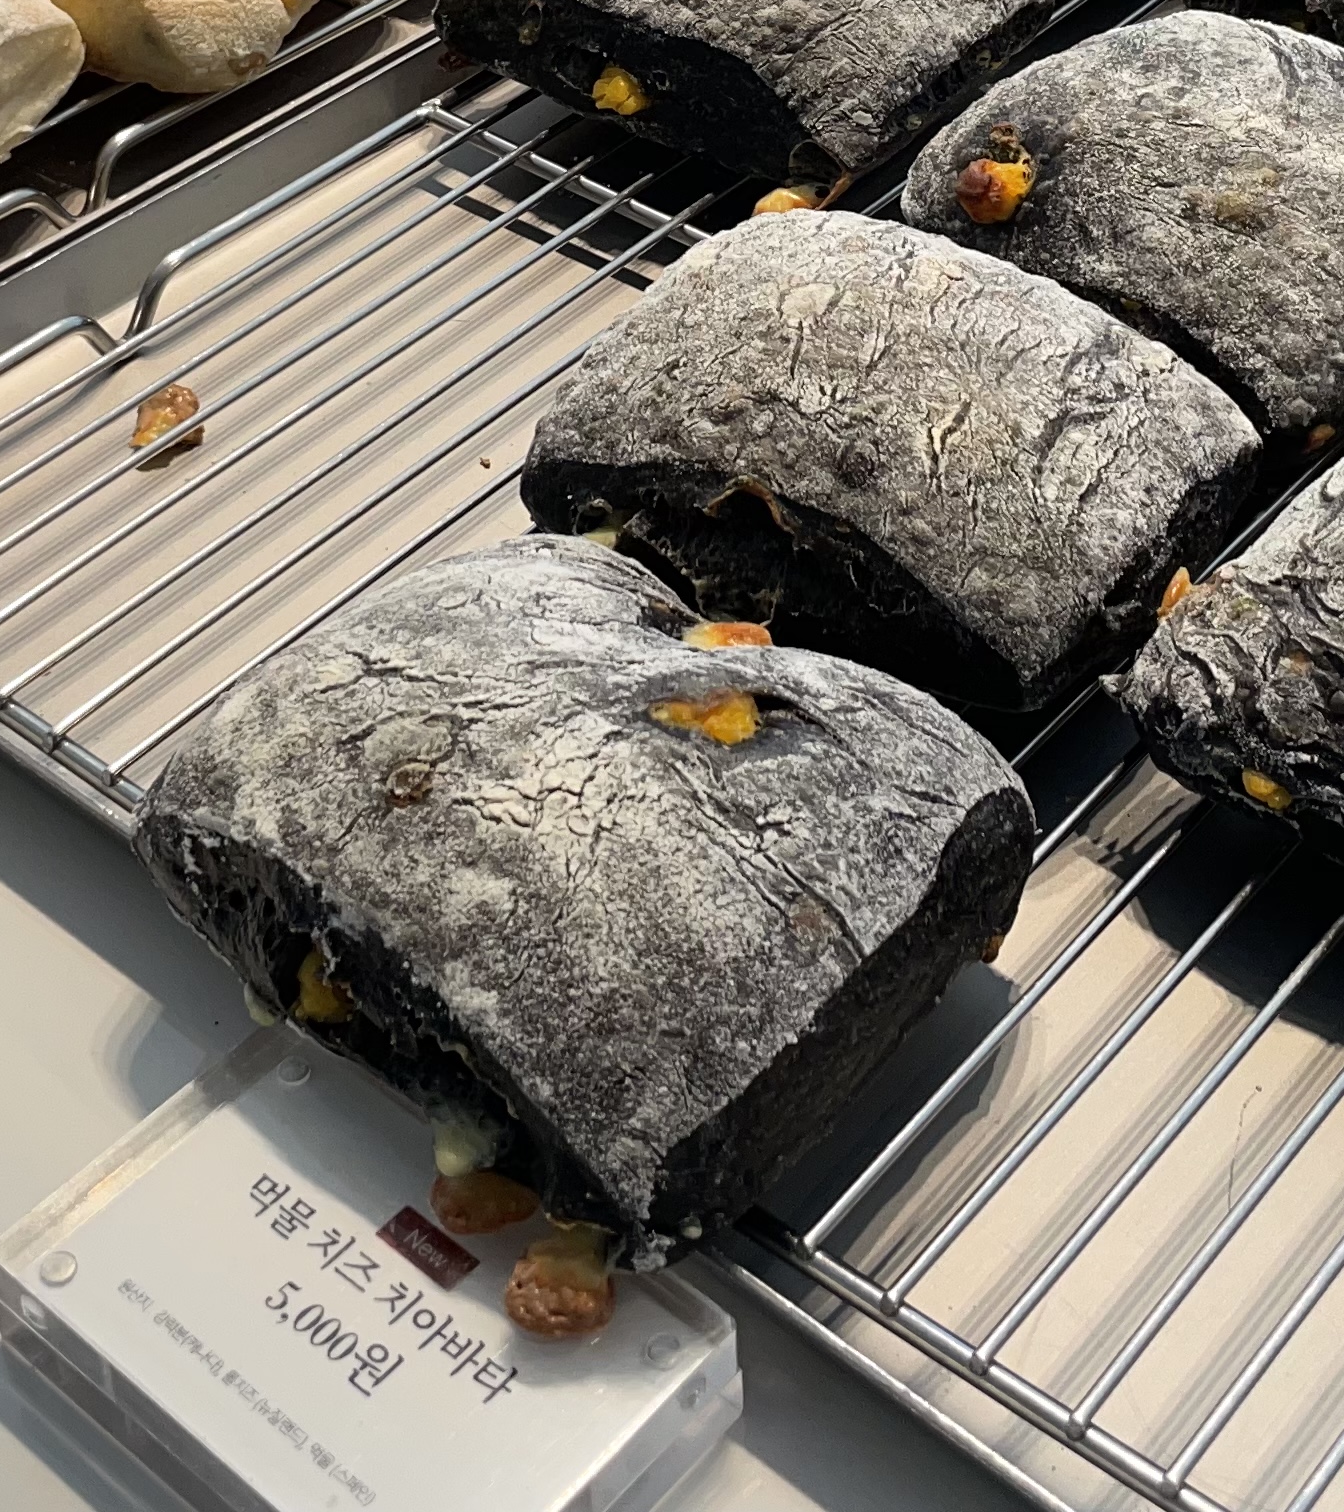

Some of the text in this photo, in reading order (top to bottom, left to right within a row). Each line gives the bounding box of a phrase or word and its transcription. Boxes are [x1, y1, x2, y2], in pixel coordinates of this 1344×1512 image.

[250, 1173, 518, 1404] 먹물 치즈 치아바타
[402, 1227, 449, 1268] New
[265, 1281, 404, 1397] 5,000원
